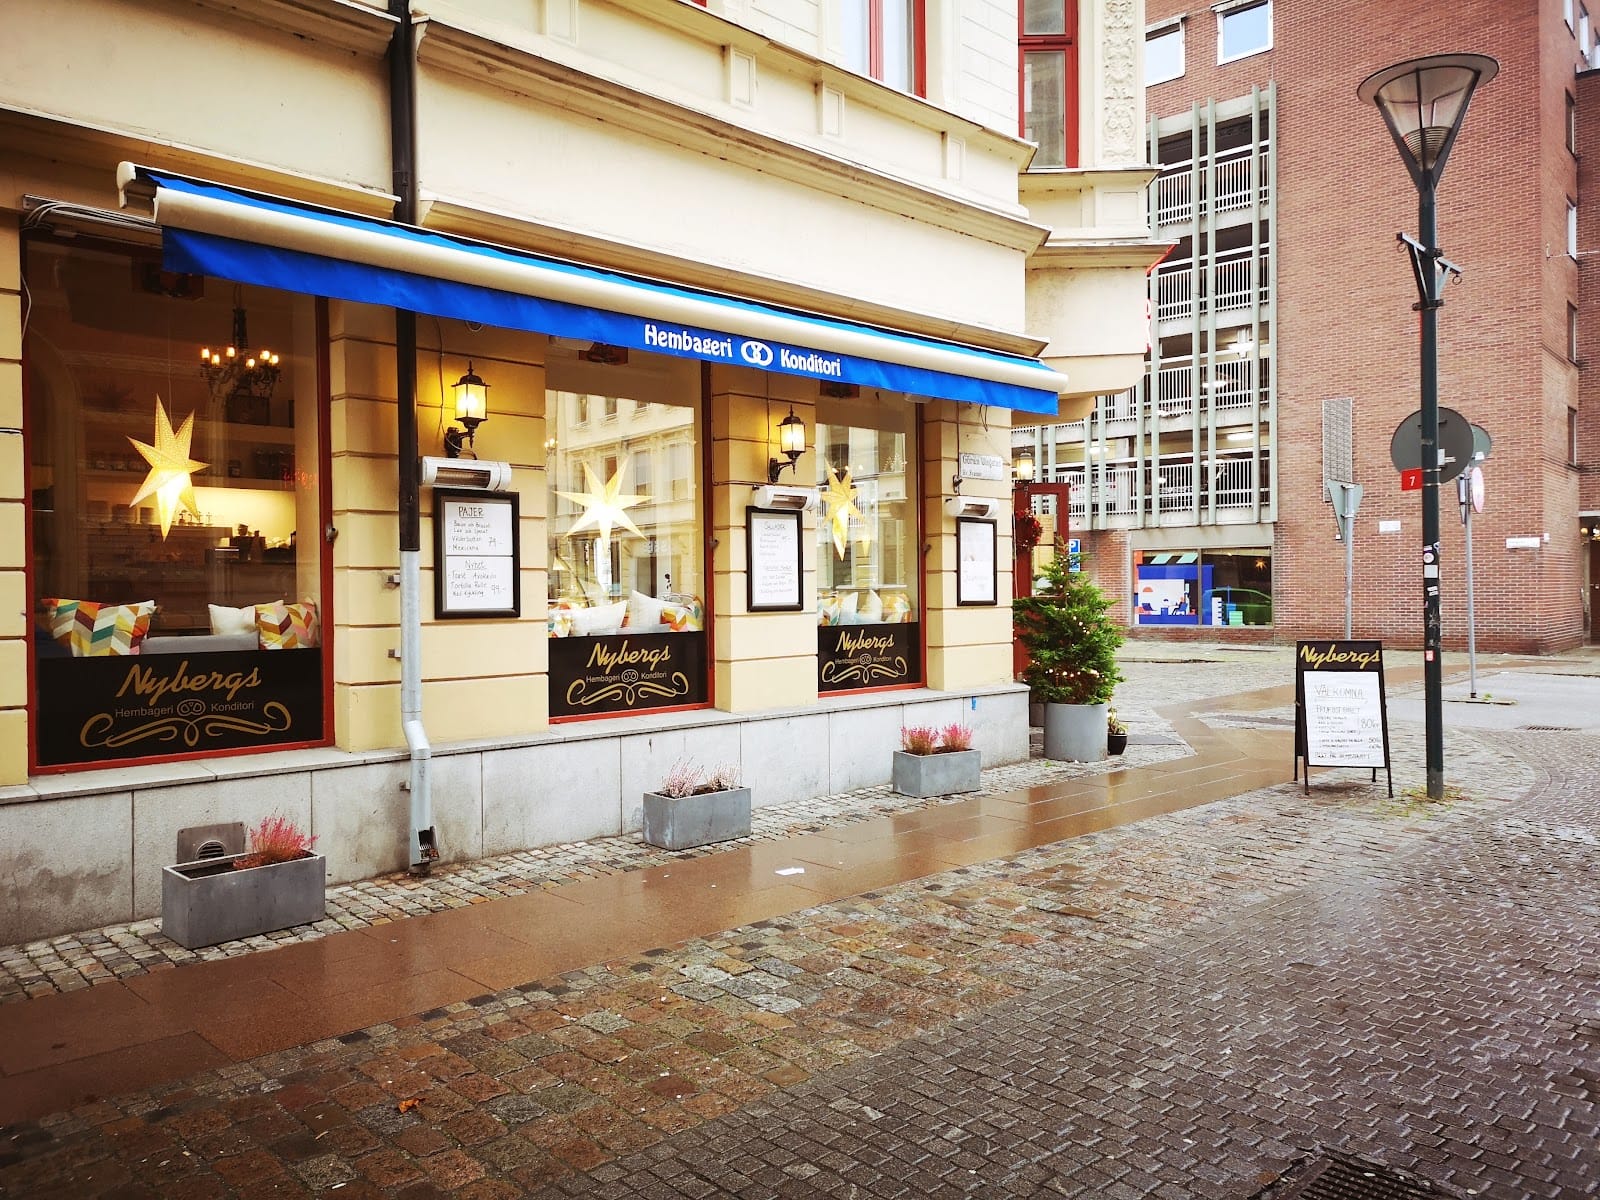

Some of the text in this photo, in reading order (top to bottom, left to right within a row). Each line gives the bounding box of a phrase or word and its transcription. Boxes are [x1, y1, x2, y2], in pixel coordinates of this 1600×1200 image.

[645, 324, 842, 377] Hembageri Konditori
[1409, 476, 1416, 486] 7
[458, 506, 484, 517] PAJER
[586, 639, 671, 675] Nybergs
[835, 629, 895, 658] Nybergs
[1300, 643, 1381, 670] Nybergs
[115, 660, 262, 706] Nybergs
[585, 671, 668, 684] Hembageri Konditori
[115, 701, 255, 718] Hembageri Konditori
